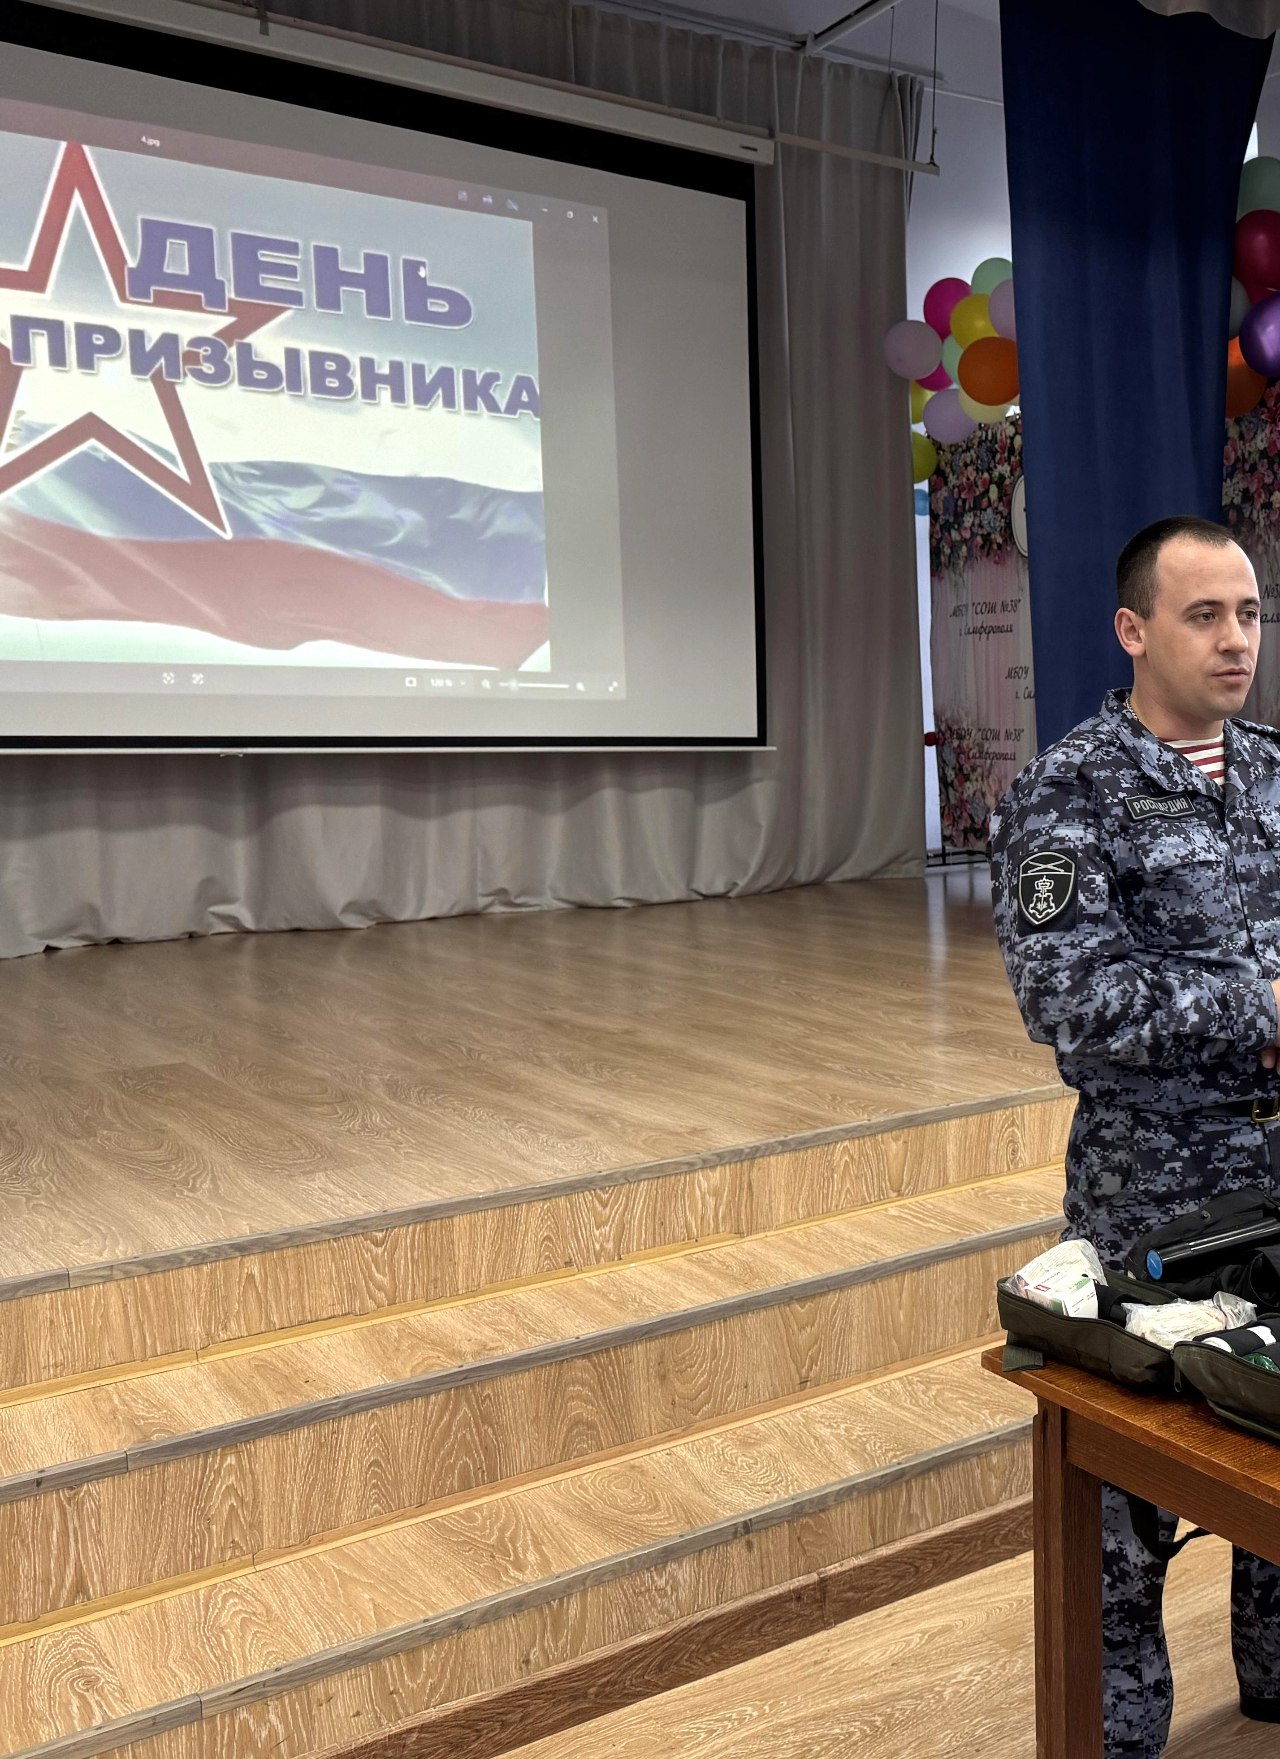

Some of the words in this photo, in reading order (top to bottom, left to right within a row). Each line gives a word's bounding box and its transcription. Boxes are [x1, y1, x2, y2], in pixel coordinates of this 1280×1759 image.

[126, 216, 474, 331] ДЕНЬ
[9, 313, 540, 420] ПРИЗЫВНИКА
[1005, 666, 1030, 680] МБОУ
